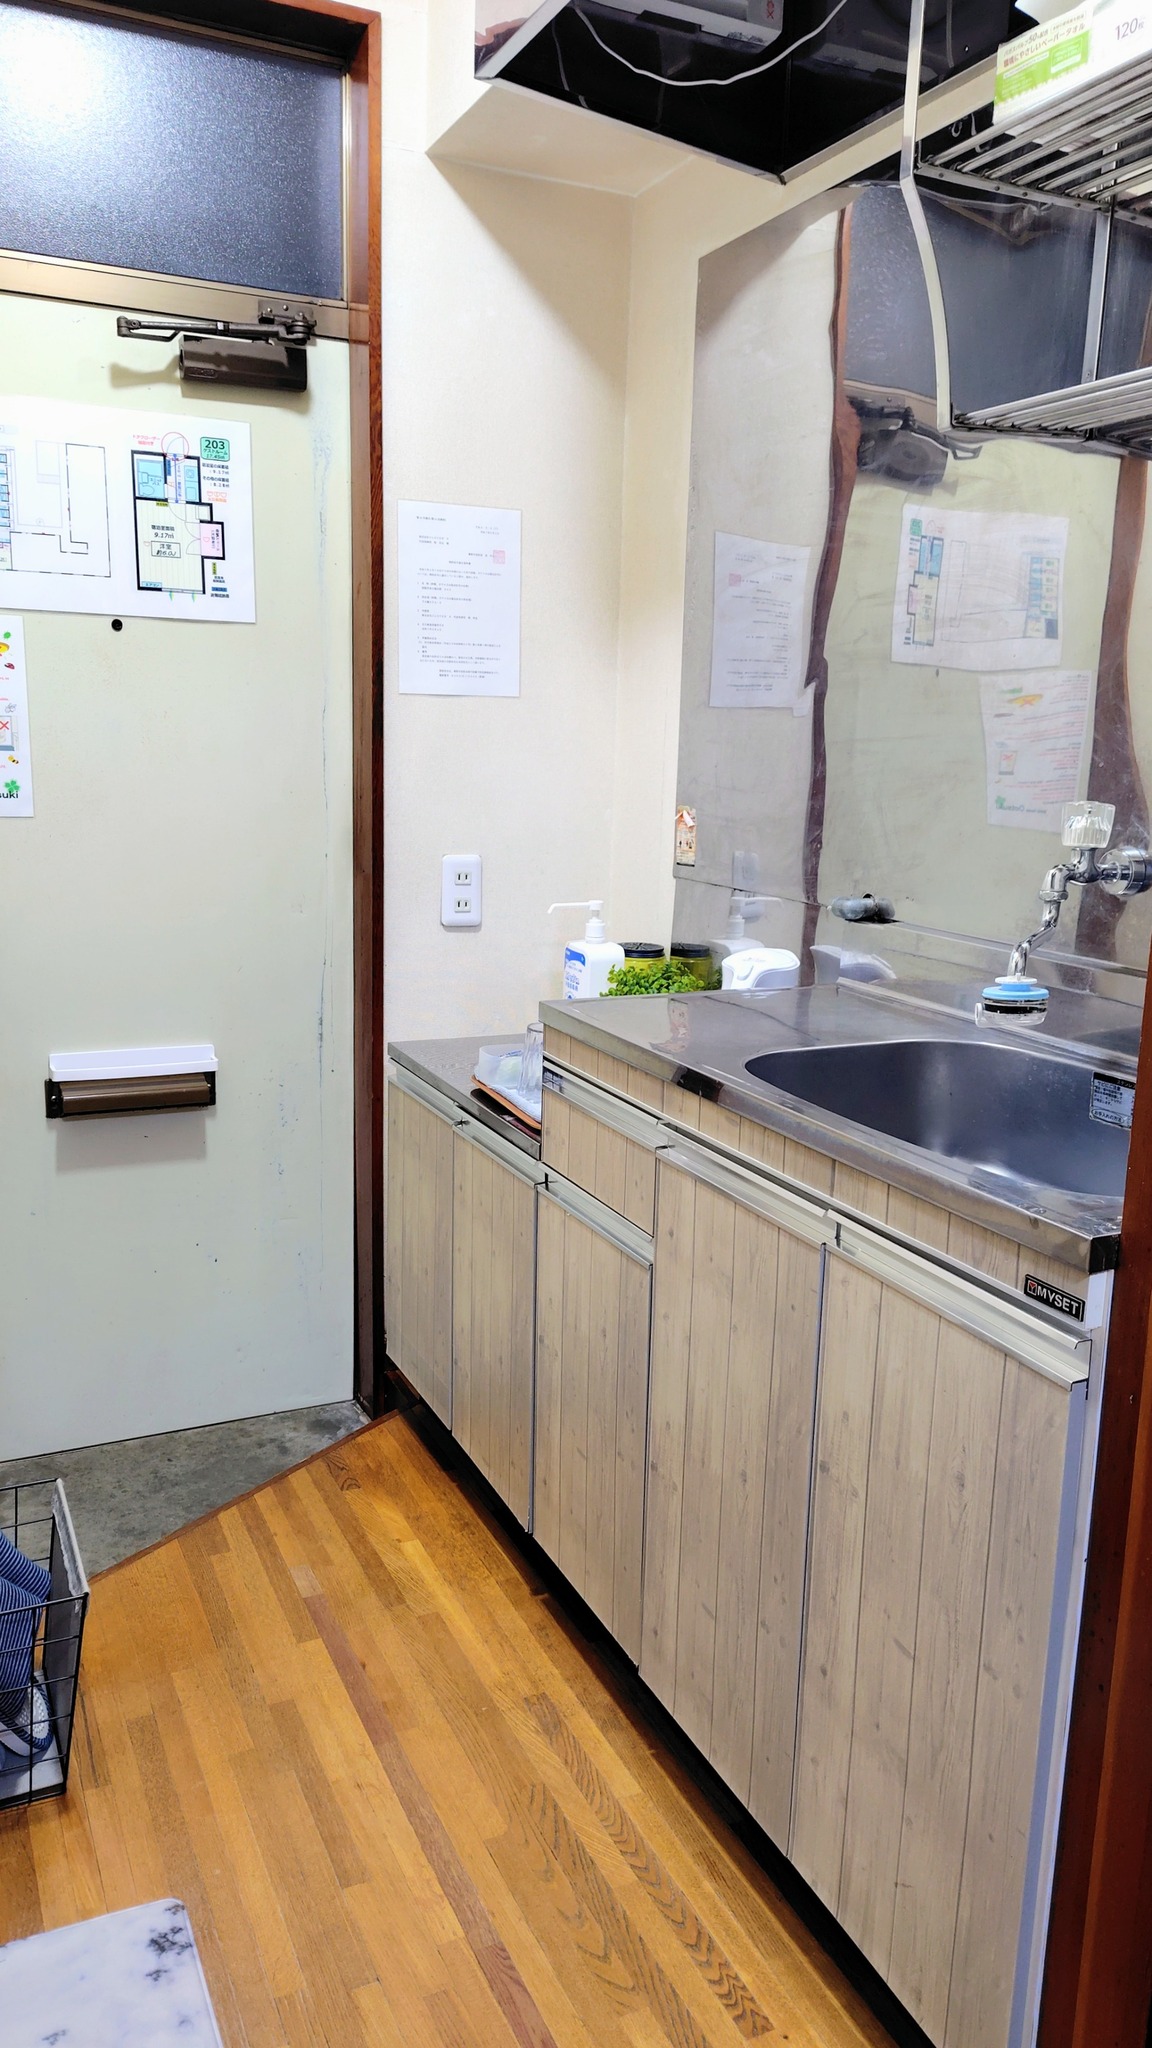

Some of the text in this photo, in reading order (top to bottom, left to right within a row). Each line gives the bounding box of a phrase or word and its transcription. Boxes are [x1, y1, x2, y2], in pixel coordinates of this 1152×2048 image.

[205, 439, 226, 450] 203
[203, 448, 228, 456] ゲストルーム
[1037, 1285, 1079, 1315] MYSET
